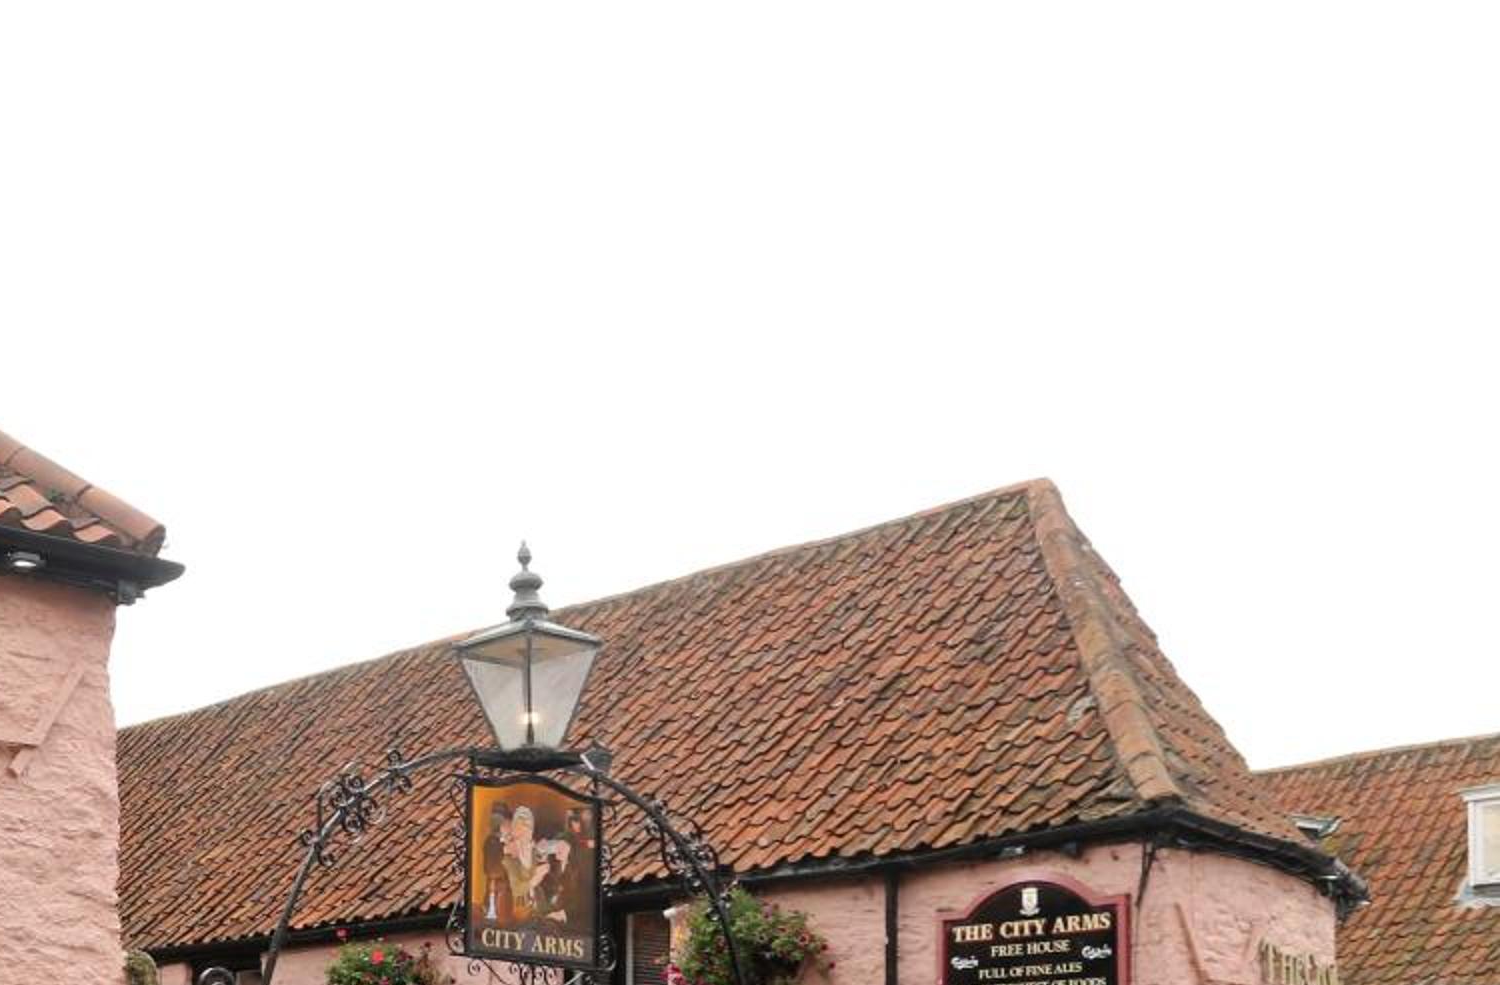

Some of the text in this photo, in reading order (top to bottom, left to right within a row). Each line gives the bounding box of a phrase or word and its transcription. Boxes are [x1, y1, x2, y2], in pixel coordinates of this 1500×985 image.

[953, 912, 1111, 942] THE CITY ARMS
[482, 928, 584, 958] CITY ARMS
[990, 943, 1024, 957] FREE
[1027, 939, 1071, 955] HOUSE
[979, 961, 1083, 980] FULL OF FINE ALES
